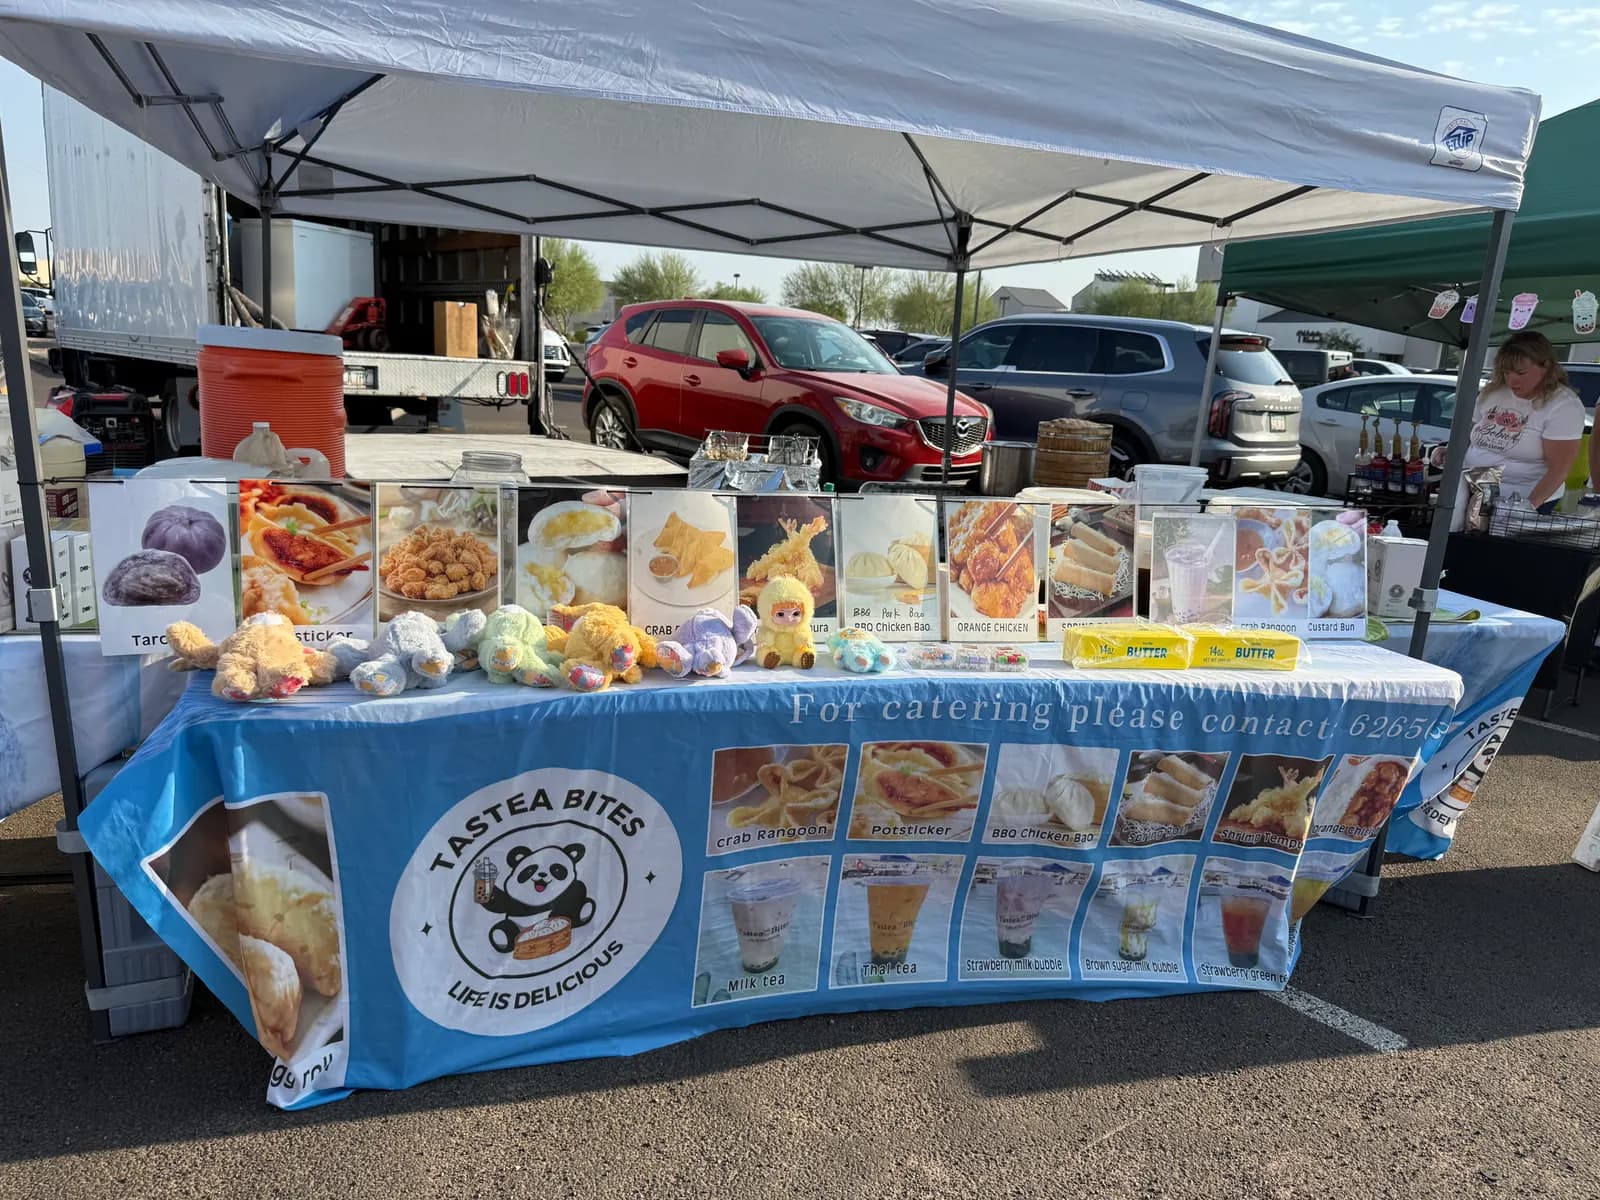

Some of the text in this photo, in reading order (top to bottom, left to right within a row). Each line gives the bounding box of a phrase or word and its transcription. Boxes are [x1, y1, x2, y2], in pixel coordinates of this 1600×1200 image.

[853, 608, 871, 617] BBQ
[881, 607, 901, 619] Pork
[645, 625, 672, 636] CRAB
[876, 622, 912, 632] Chicken
[914, 622, 930, 632] Bao
[957, 622, 1029, 632] ORANGE CHICKEN
[1307, 622, 1355, 632] Custard Bun
[1126, 646, 1168, 658] BUTTER
[1235, 647, 1275, 659] BUTTER
[790, 693, 863, 724] For
[883, 694, 1054, 731] catering
[1066, 696, 1184, 733] please
[1464, 707, 1519, 740] TASTE
[429, 788, 645, 871] TASTEA BITES
[757, 824, 828, 841] Rangoon
[871, 824, 952, 836] Potsticker
[992, 828, 1094, 844] BBQ Chicken Bao
[1222, 829, 1261, 844] Shrimp
[862, 962, 917, 978] Thai tea
[966, 958, 1062, 973] Strawberry milk bubble
[1086, 959, 1110, 971] Brown
[1112, 960, 1133, 974] sugar
[1152, 962, 1179, 974] bubble
[1201, 963, 1249, 979] Strawberry
[1250, 967, 1276, 983] green
[448, 940, 624, 1010] LIFE IS DELICIOUS
[728, 974, 785, 992] Milk tea
